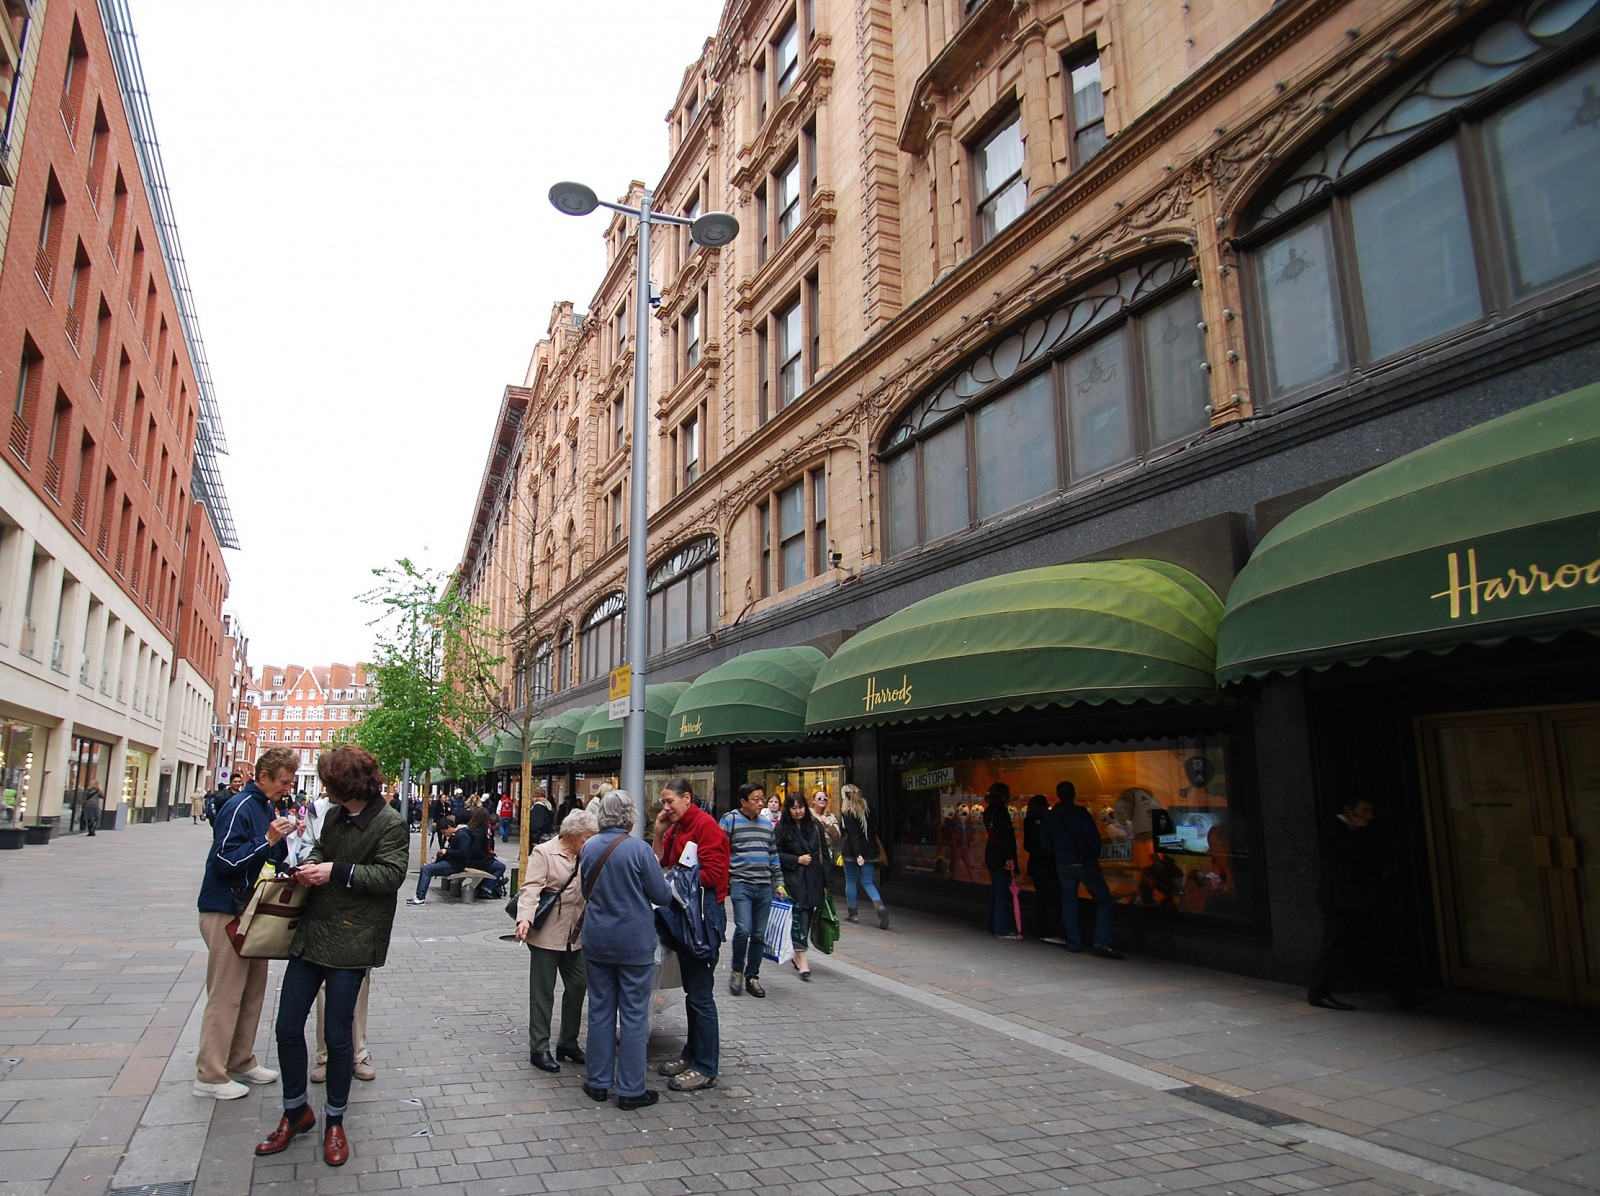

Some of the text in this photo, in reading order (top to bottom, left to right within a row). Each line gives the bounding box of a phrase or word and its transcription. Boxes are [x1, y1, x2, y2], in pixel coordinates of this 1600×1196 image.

[862, 674, 912, 712] Harrods
[680, 714, 702, 738] Harrods
[907, 776, 914, 789] A
